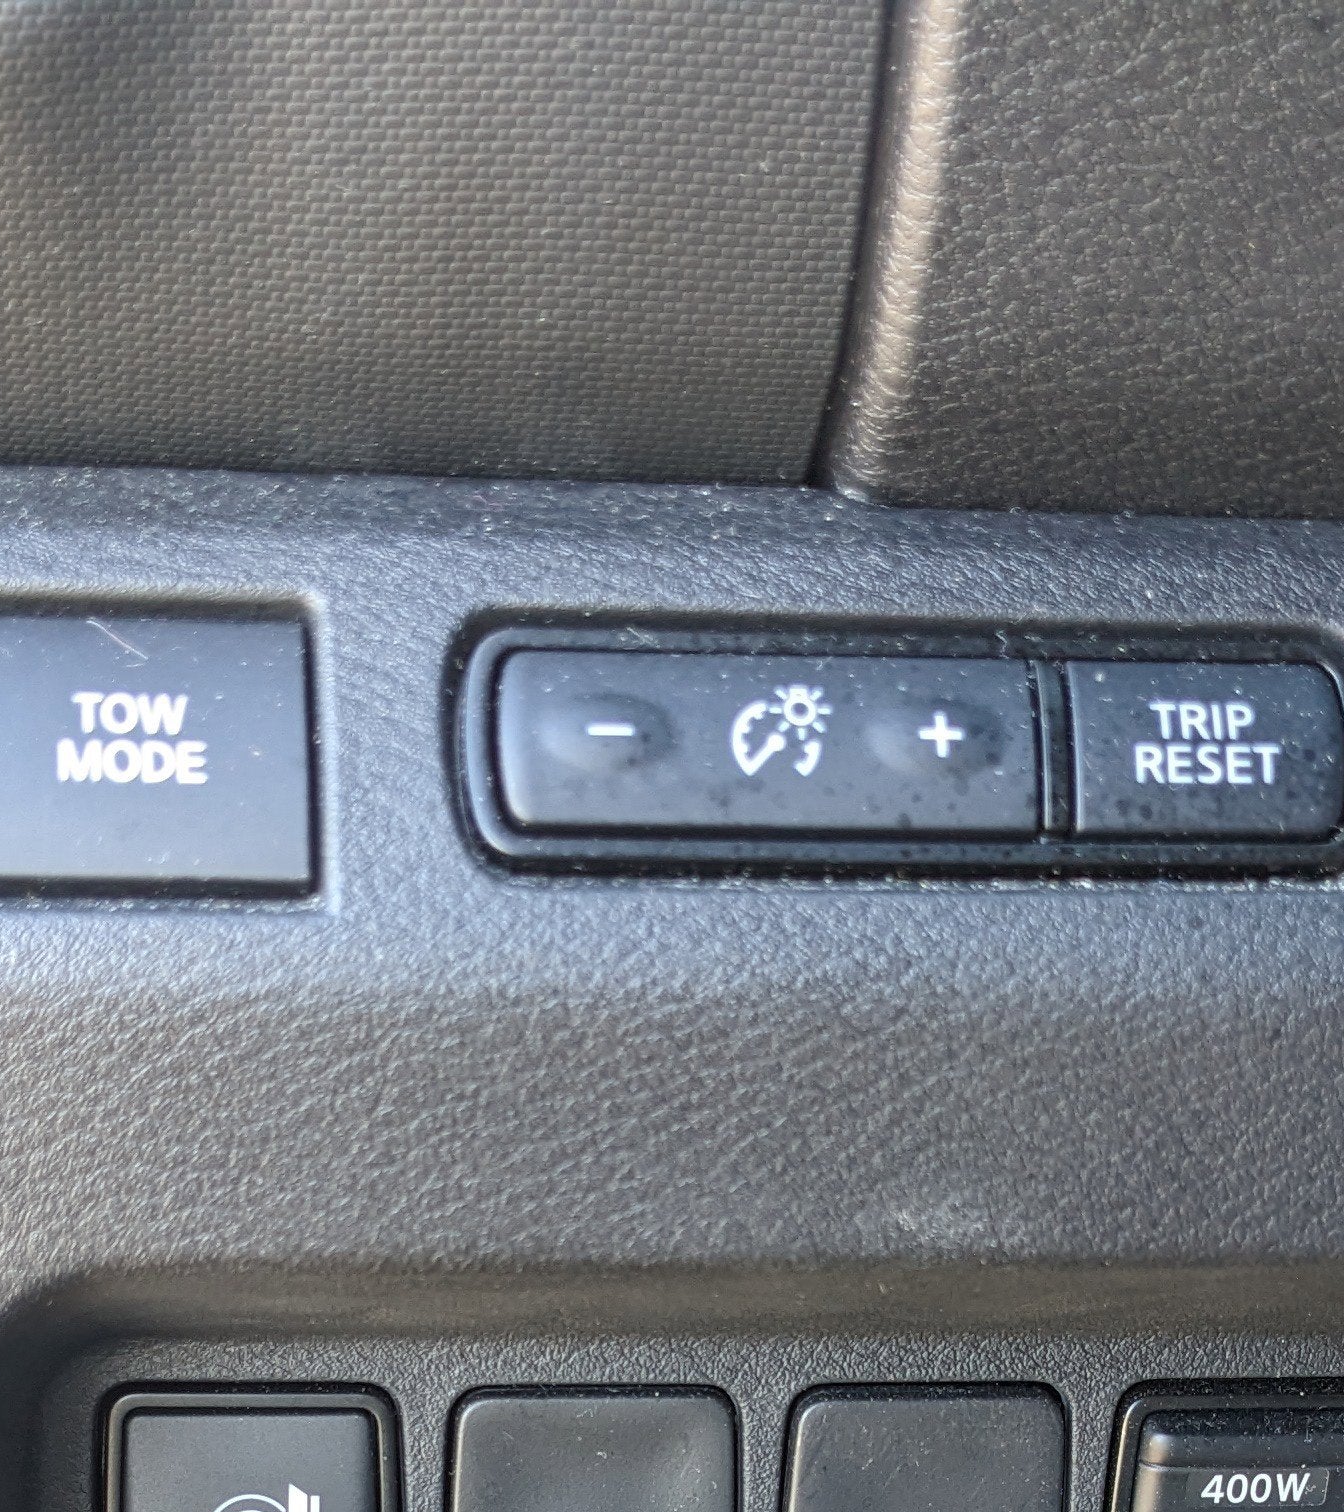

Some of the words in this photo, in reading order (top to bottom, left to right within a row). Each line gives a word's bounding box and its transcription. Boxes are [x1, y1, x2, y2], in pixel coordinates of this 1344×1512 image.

[70, 691, 188, 736] TOW
[1148, 701, 1256, 741] TRIP
[55, 739, 209, 785] MODE
[1133, 744, 1281, 785] RESET
[1200, 1472, 1311, 1505] 400W
